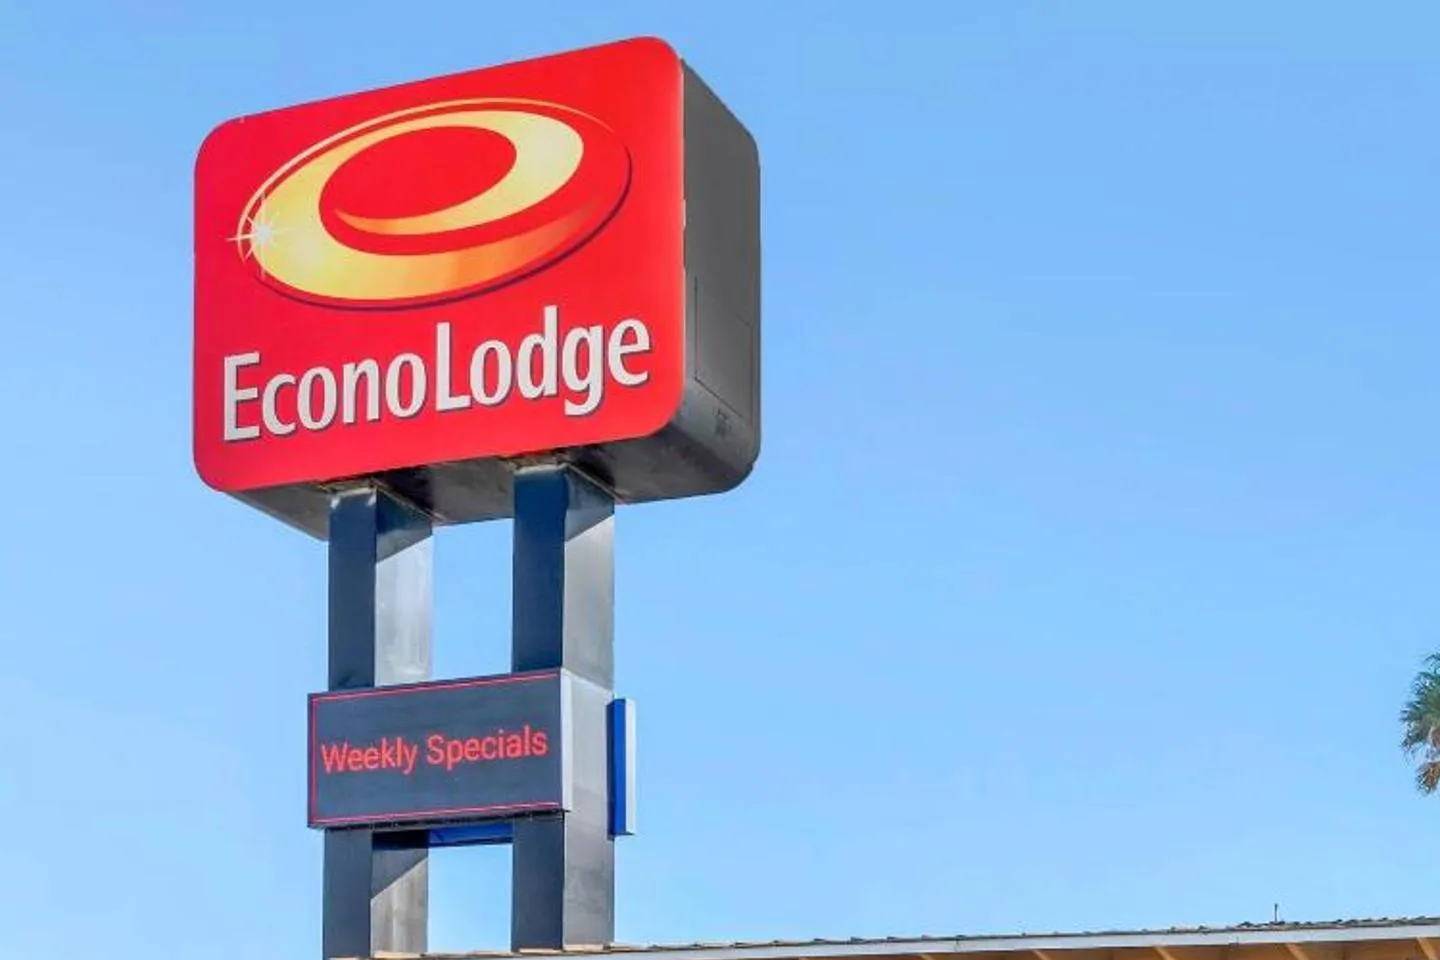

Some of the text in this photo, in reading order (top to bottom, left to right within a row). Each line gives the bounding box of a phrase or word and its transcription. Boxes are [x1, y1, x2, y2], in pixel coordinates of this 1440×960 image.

[222, 304, 652, 443] EconoLodge
[321, 725, 548, 775] Weekly Specials
